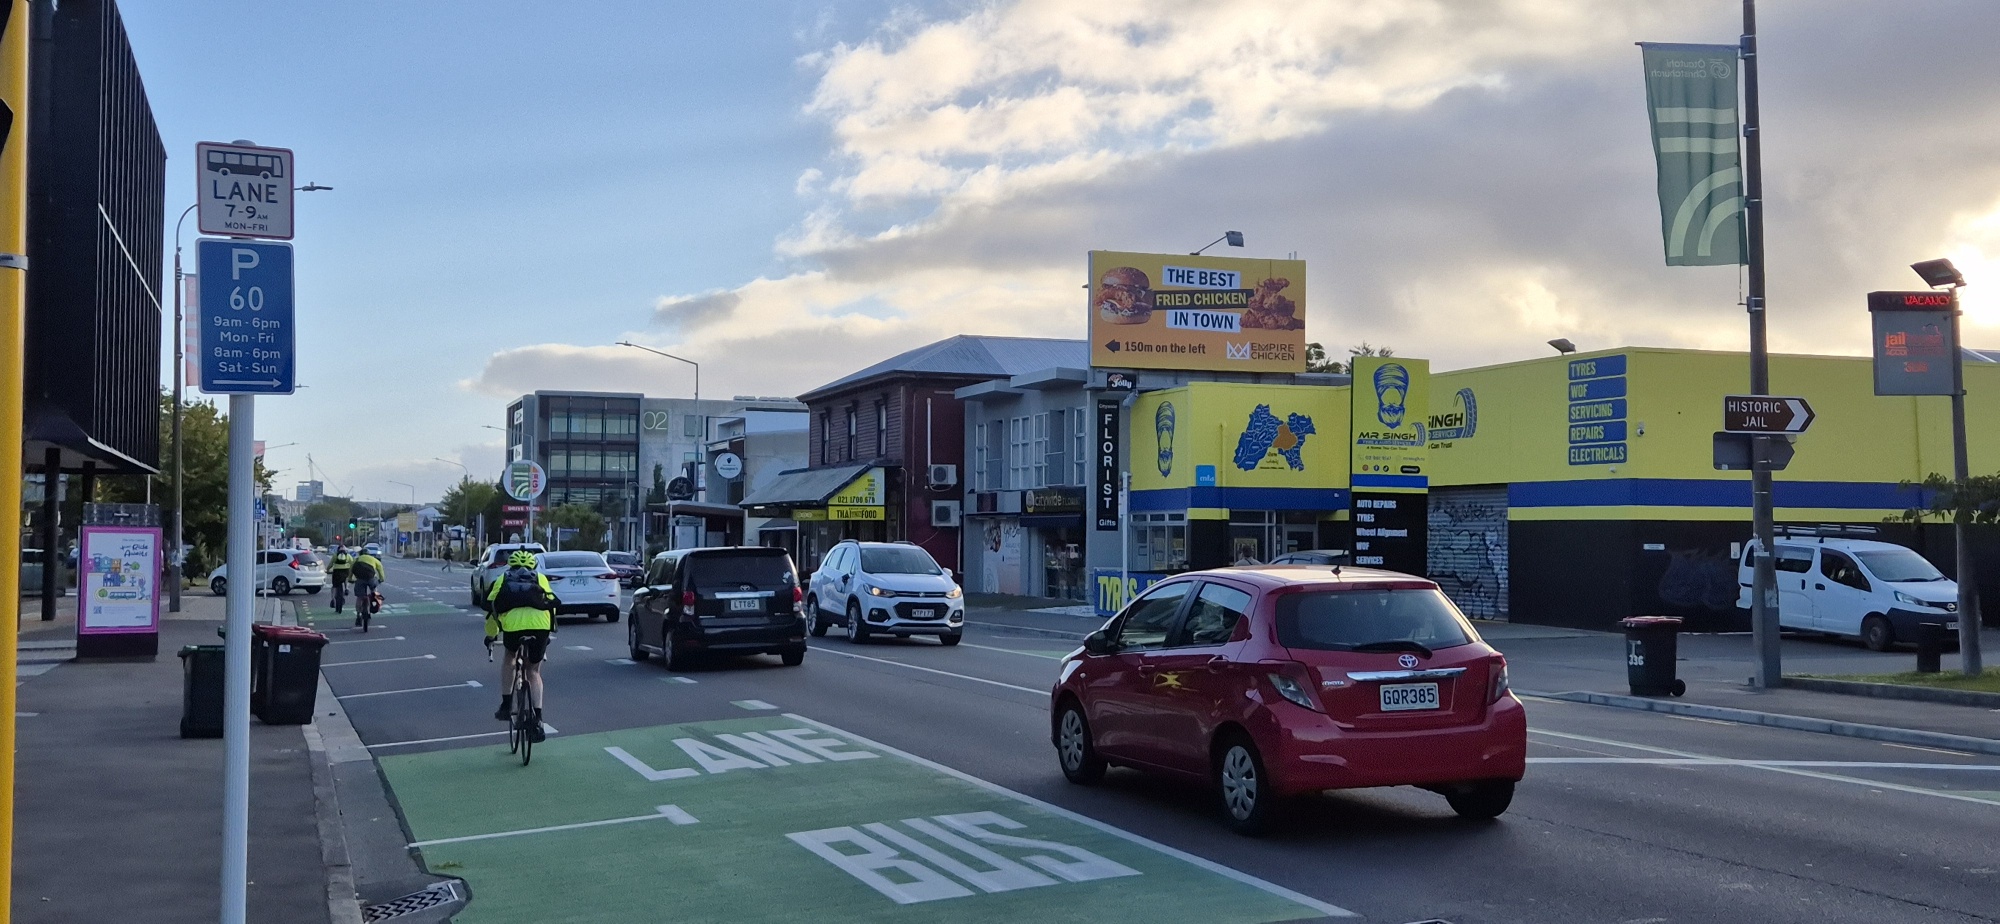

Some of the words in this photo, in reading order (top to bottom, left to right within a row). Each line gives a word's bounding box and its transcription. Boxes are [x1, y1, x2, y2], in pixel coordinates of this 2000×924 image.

[213, 180, 278, 203] LANE
[225, 222, 268, 231] MON-FRI
[232, 247, 260, 280] P
[1167, 269, 1194, 284] THE
[1200, 271, 1235, 287] BEST
[229, 286, 264, 311] 60
[1156, 294, 1191, 306] FRIED
[1194, 292, 1247, 304] CHICKEN
[1904, 295, 1951, 305] VACANCY
[213, 316, 242, 327] 9am
[252, 318, 280, 330] 6pm
[1174, 312, 1189, 326] IN
[1193, 313, 1234, 329] TOWN
[220, 332, 249, 343] Mon
[258, 333, 274, 343] Fri
[214, 347, 242, 358] 8am
[252, 348, 280, 360] 6pm
[1125, 341, 1153, 353] 150m
[1155, 344, 1168, 353] on
[1170, 343, 1186, 353] the
[1188, 343, 1206, 354] left
[1251, 343, 1295, 352] EMPIRE
[1251, 352, 1295, 361] CHICKEN
[218, 362, 242, 373] Sat
[252, 363, 277, 373] Sun
[1571, 362, 1596, 377] TYRES
[1112, 378, 1132, 389] Jolly
[1571, 384, 1588, 398] WOF
[1571, 403, 1613, 419] SERVICING
[1728, 401, 1781, 413] HISTORIC
[643, 412, 668, 430] 02
[1428, 413, 1463, 428] INGH
[1742, 416, 1768, 427] JAIL
[1382, 432, 1417, 440] SINGH
[1432, 430, 1456, 439] SERVICES
[1571, 426, 1604, 440] REPAIRS
[1570, 446, 1624, 462] ELECTRICALS
[1103, 414, 1113, 509] FLORIST
[1357, 500, 1372, 508] AUTO
[1373, 500, 1396, 508] REPAIRS
[861, 510, 877, 518] FOOD
[1357, 513, 1375, 522] TYRES
[1099, 519, 1116, 527] Gifts
[1356, 528, 1376, 536] Wheel
[1377, 528, 1408, 537] Alignment
[1356, 542, 1369, 550] WOF
[1356, 556, 1383, 564] SERVICES
[1098, 576, 1138, 611] TYRS
[733, 600, 756, 608] LTT85
[1383, 688, 1435, 705] GQR385
[604, 728, 881, 780] LANE
[785, 811, 1143, 904] BUS
